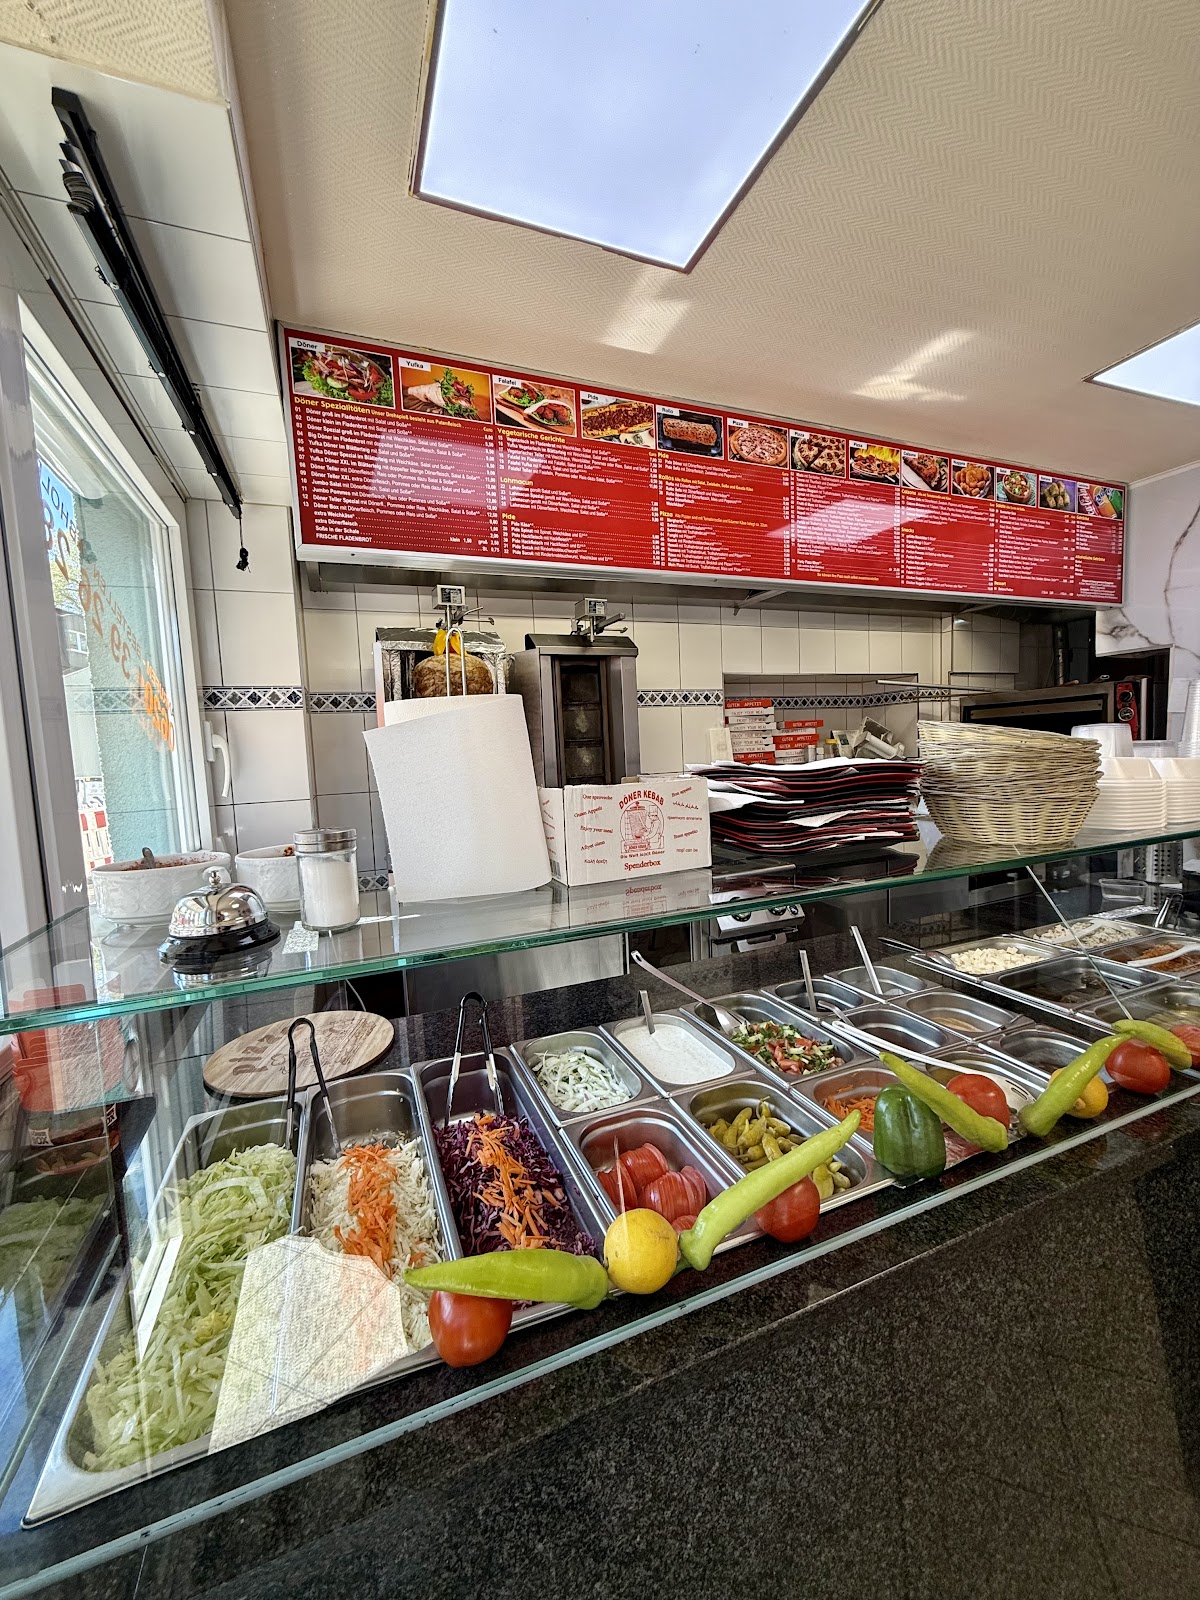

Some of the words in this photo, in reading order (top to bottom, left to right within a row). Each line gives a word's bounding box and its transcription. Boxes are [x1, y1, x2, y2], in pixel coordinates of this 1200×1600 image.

[297, 341, 318, 350] Döner
[406, 360, 424, 369] Yufka
[498, 378, 517, 386] Falafel
[294, 396, 318, 406] Döner
[320, 401, 370, 414] Spezialitäten
[341, 412, 366, 421] Fladenbrot
[342, 420, 367, 429] Fladenbrot
[360, 431, 384, 439] Fladenbrot
[497, 427, 538, 439] Vegetarische
[540, 434, 565, 443] Gerichte
[340, 436, 365, 444] Fladenbrot
[500, 476, 533, 486] Lahmacun
[619, 790, 641, 809] DÖNER
[644, 790, 664, 806] KEBAB
[588, 806, 602, 814] Appetit
[624, 860, 661, 871] Spenderbox
